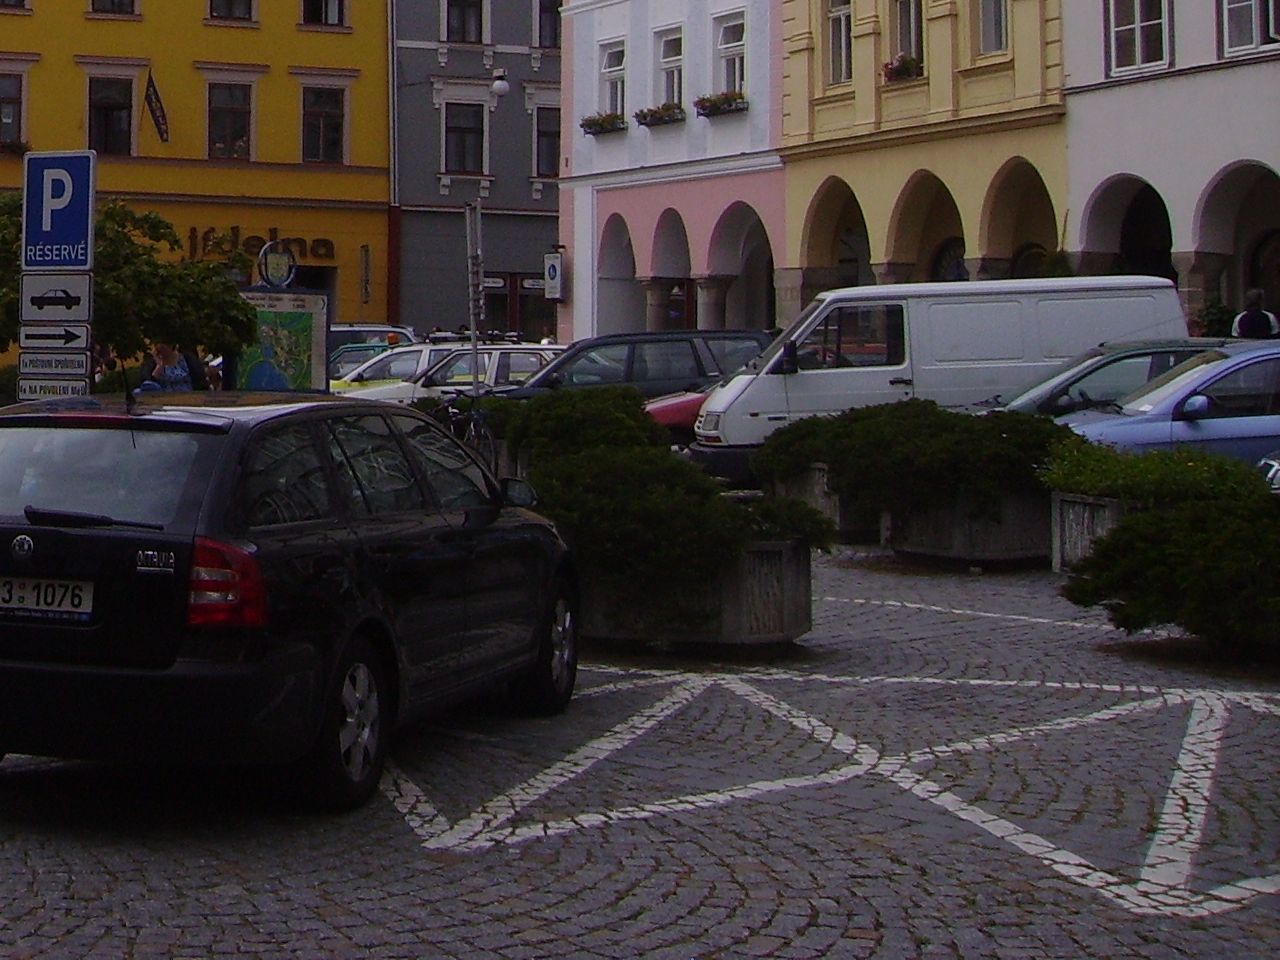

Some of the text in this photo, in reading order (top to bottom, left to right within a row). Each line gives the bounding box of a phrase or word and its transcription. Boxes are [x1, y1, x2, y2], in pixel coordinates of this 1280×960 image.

[42, 169, 73, 231] P
[26, 241, 86, 260] RÉSERVÉ
[32, 582, 83, 608] 1076
